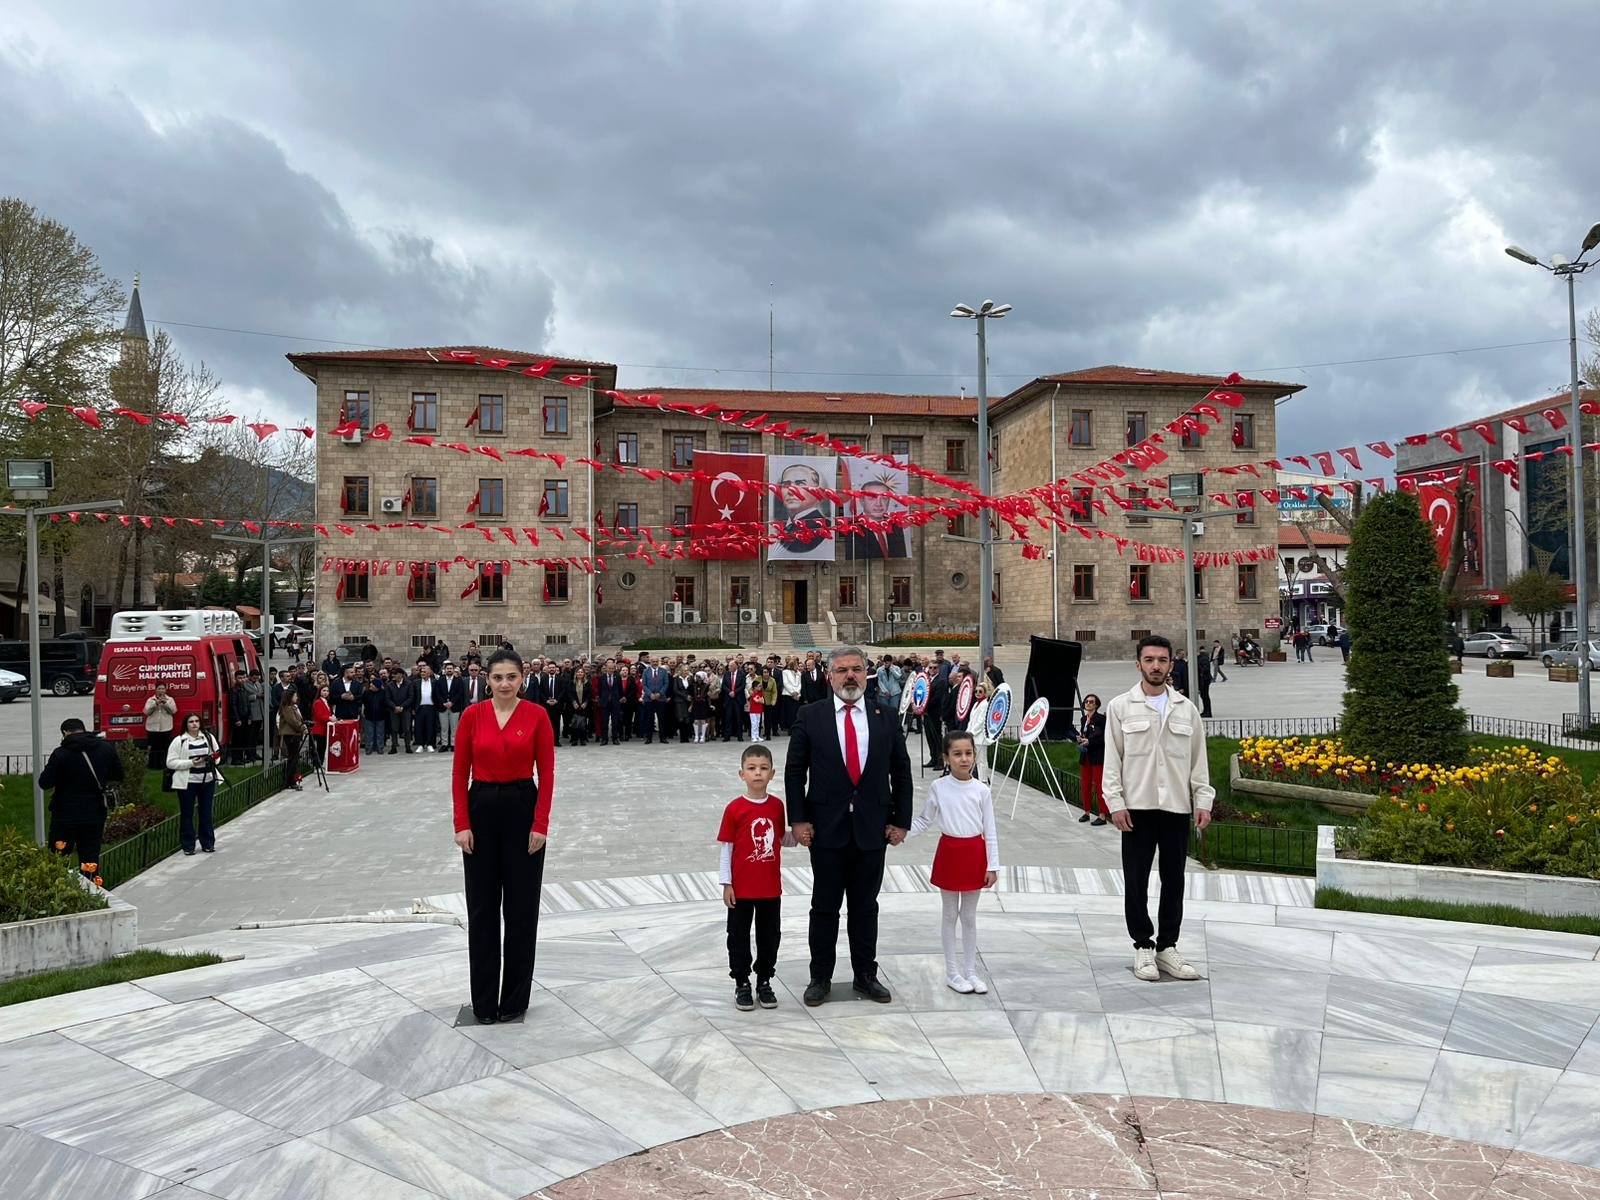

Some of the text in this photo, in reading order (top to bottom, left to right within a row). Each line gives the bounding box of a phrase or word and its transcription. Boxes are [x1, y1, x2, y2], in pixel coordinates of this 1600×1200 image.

[138, 663, 192, 672] CUMHURİYET
[162, 670, 192, 679] PARTİSİ
[112, 684, 147, 693] Türkiye'nin
